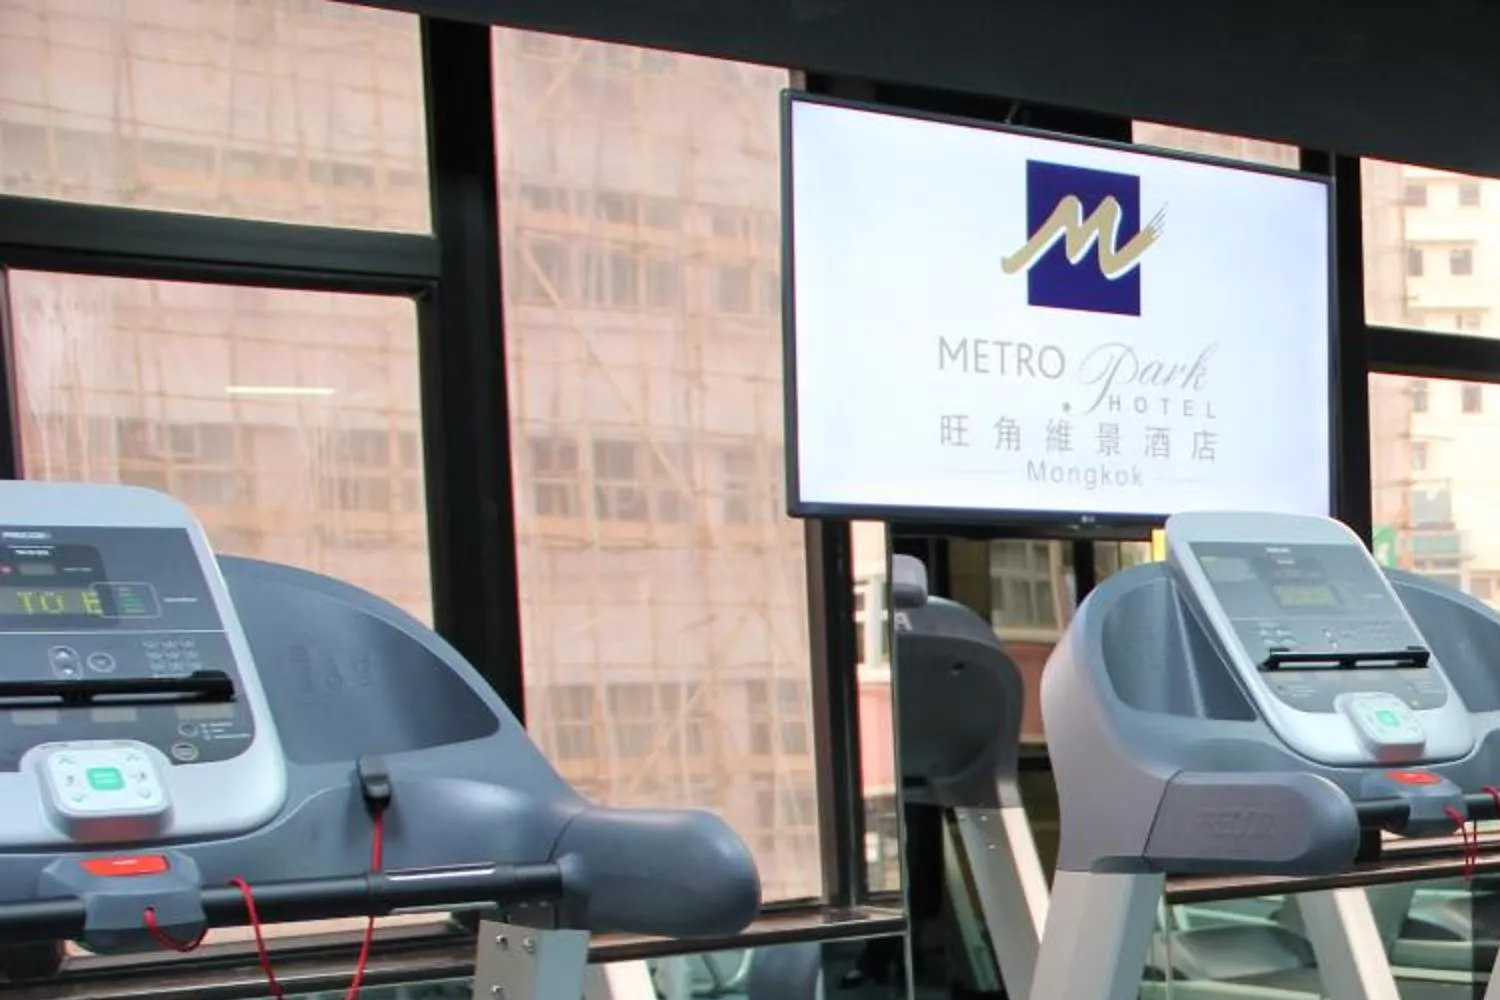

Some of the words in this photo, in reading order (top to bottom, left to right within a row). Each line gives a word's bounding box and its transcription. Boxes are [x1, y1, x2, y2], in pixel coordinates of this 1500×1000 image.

[937, 335, 1066, 380] METRO
[1064, 340, 1219, 416] Park
[1107, 393, 1217, 420] HOTEL
[939, 413, 1219, 464] 旺角維景酒店
[1026, 459, 1145, 490] Mongkok
